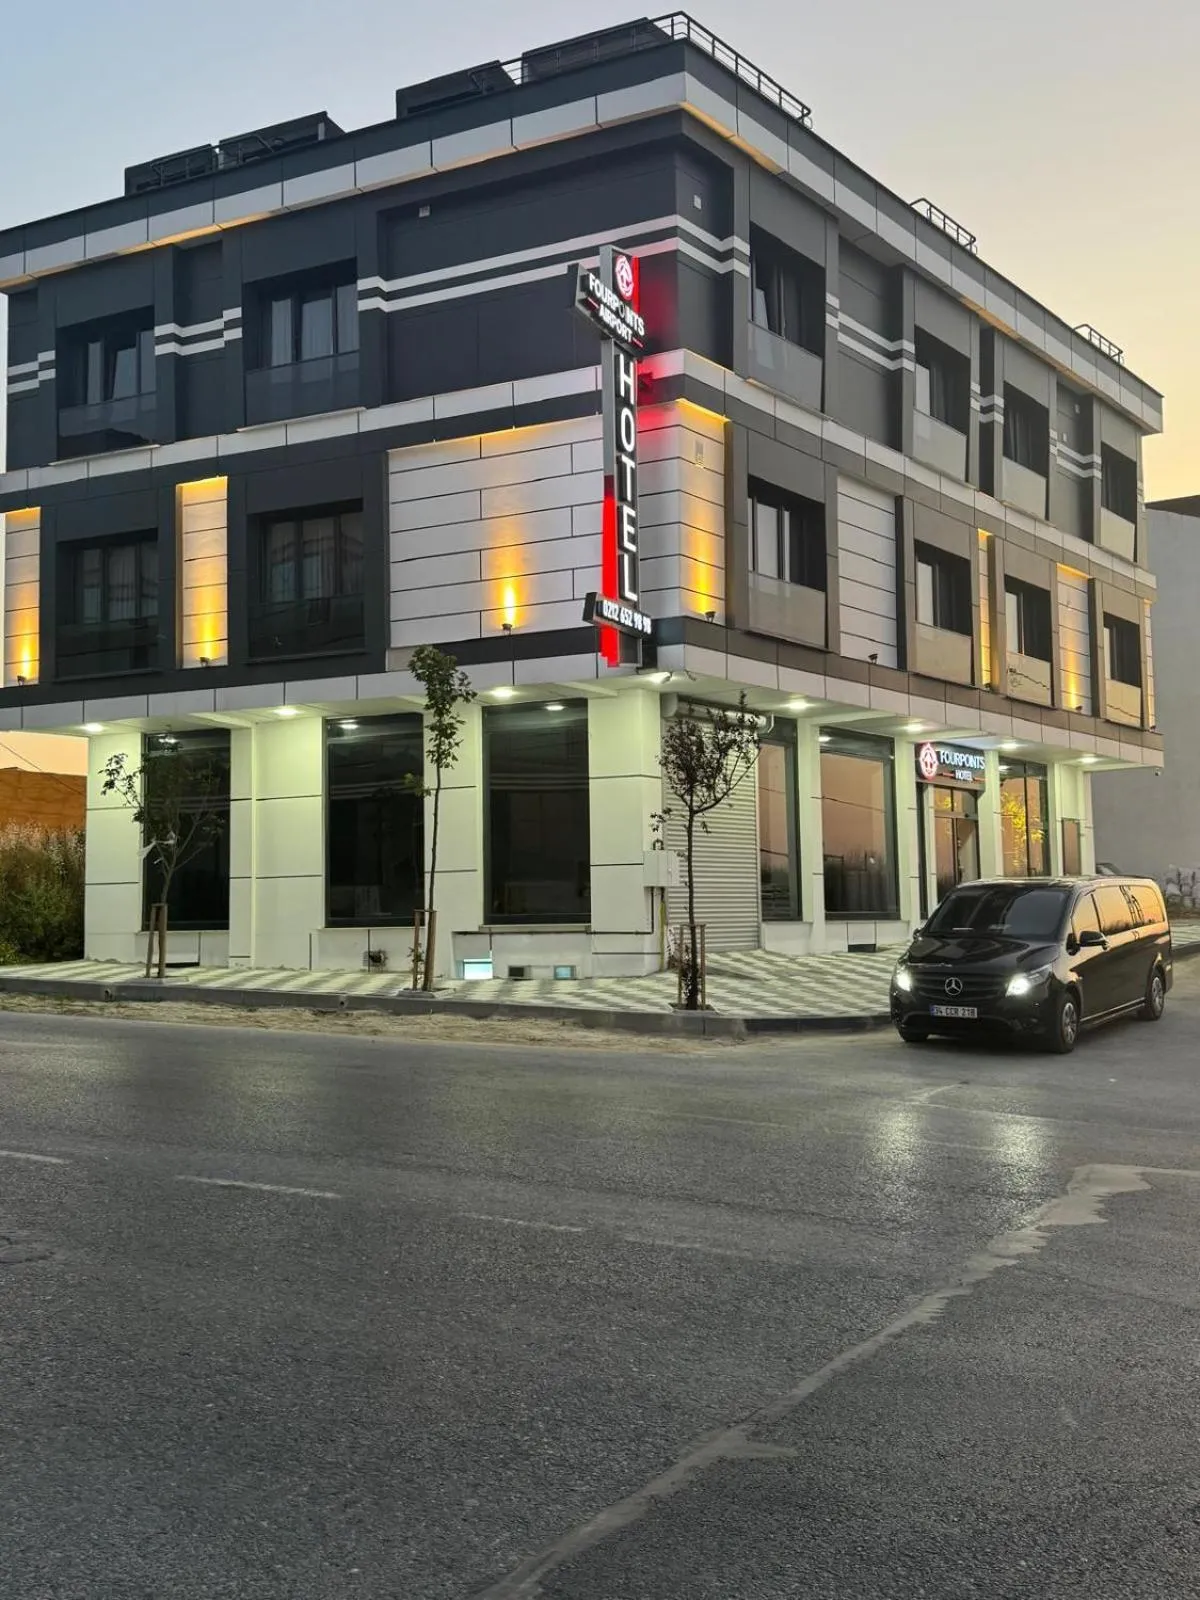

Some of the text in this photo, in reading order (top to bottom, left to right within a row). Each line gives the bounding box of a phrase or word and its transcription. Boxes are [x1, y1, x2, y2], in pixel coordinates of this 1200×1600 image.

[599, 303, 633, 342] AIRPORT
[618, 353, 639, 602] HOTEL
[603, 599, 619, 622] 0212
[620, 607, 634, 627] 652
[940, 749, 985, 770] FOURPOINTS
[955, 769, 973, 781] HOTEL
